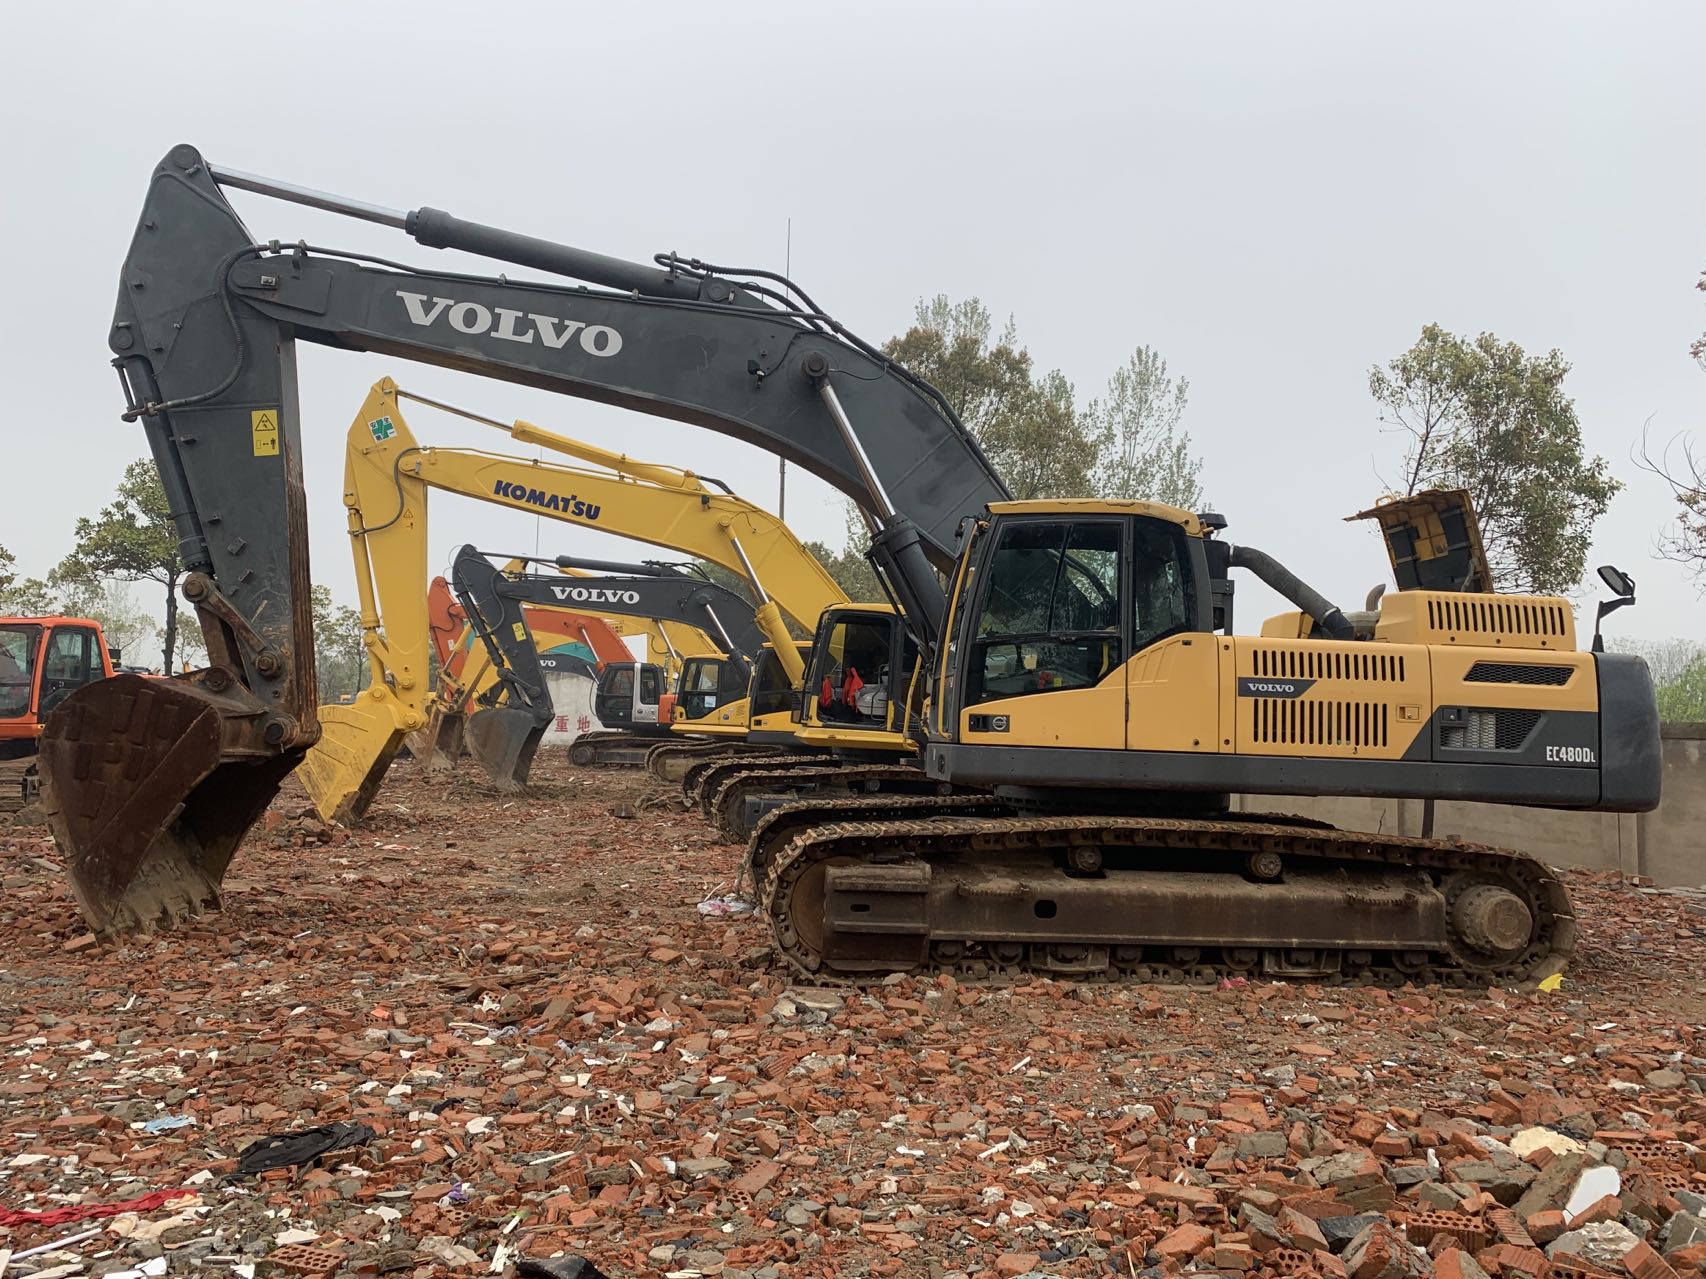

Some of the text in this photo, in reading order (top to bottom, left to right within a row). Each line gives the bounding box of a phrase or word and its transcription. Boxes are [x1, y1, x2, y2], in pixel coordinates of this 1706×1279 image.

[396, 290, 622, 357] VOLVO
[494, 480, 601, 520] KOMATSU
[550, 586, 640, 604] VOLVO
[1248, 683, 1294, 693] VOLVO
